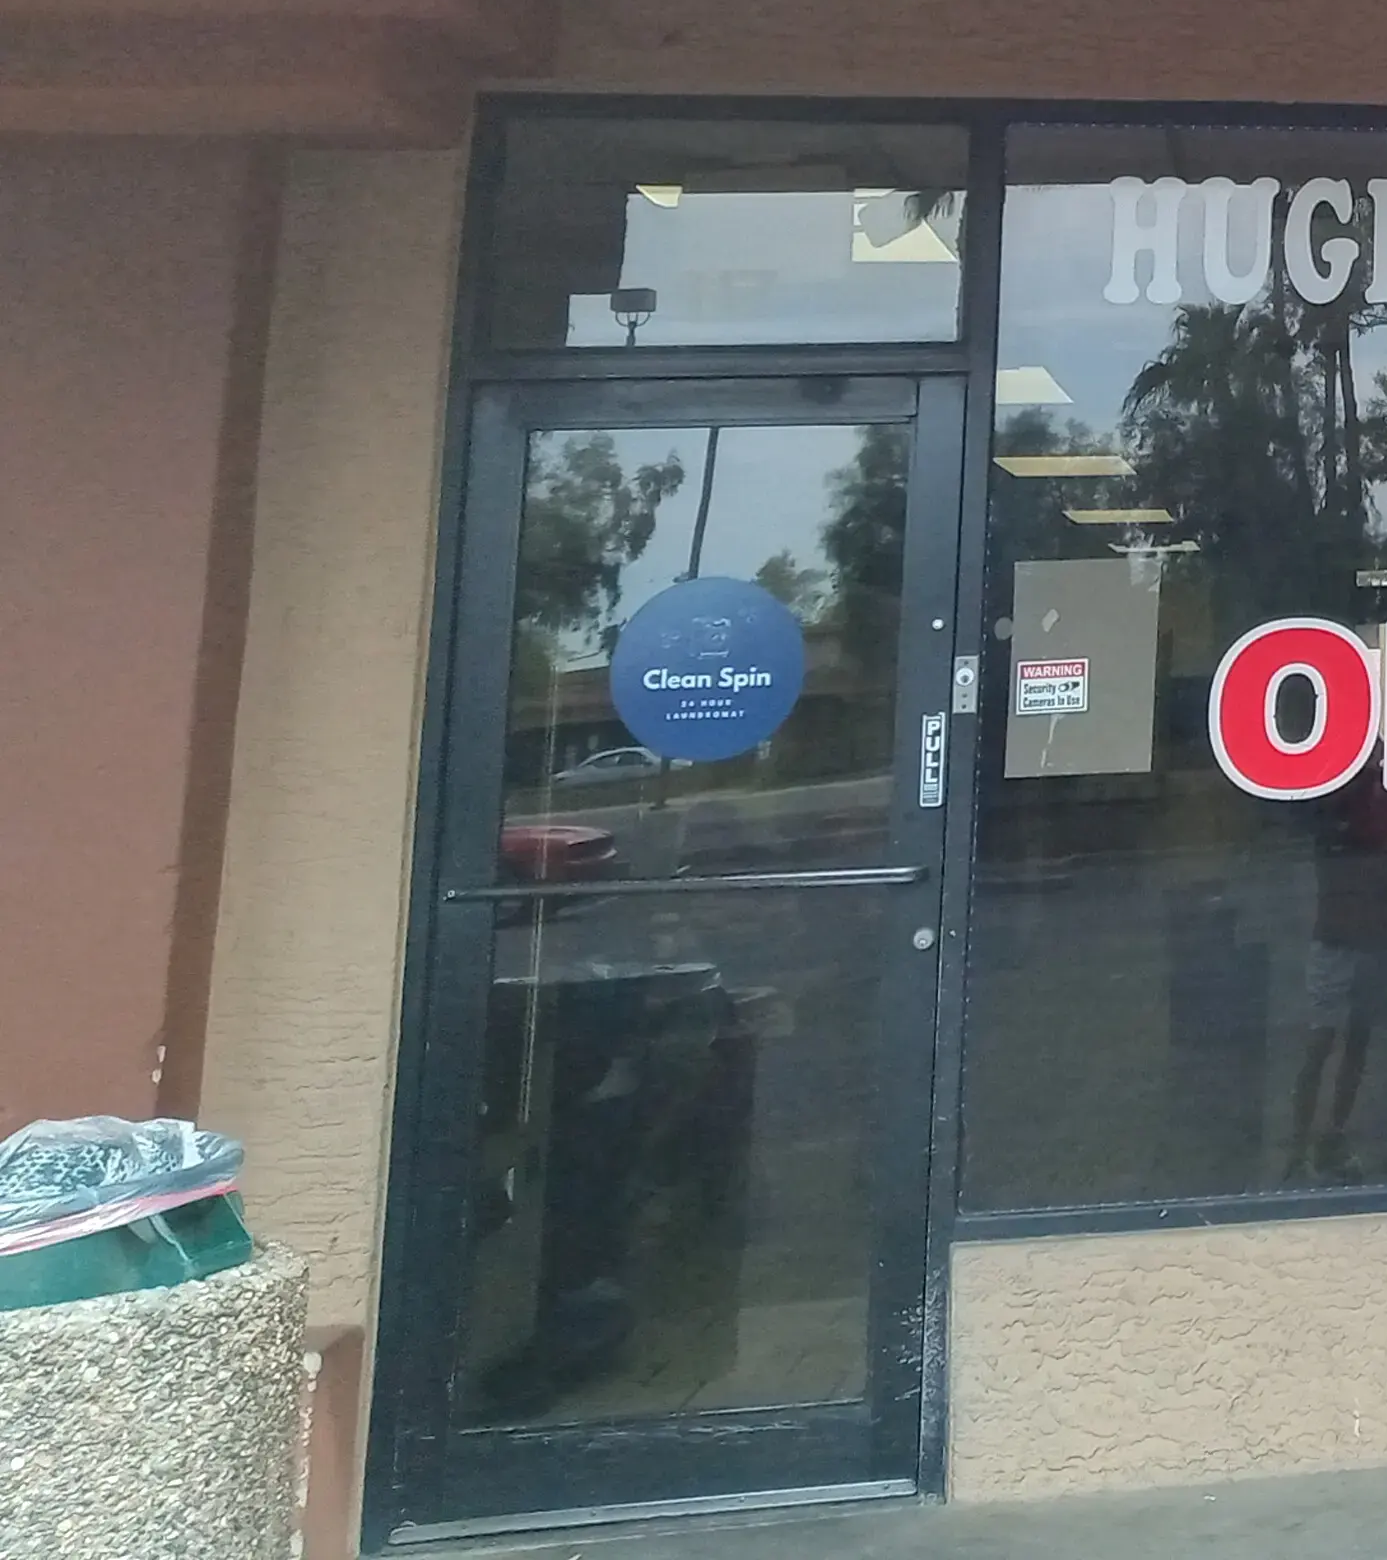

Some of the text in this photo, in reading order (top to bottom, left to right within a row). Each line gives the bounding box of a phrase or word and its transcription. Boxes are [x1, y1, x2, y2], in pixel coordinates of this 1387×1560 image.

[1023, 663, 1083, 679] WARNING
[642, 666, 772, 693] Clean Spin
[1023, 683, 1057, 696] Security
[1023, 697, 1056, 709] Cameras
[924, 720, 941, 784] PULL
